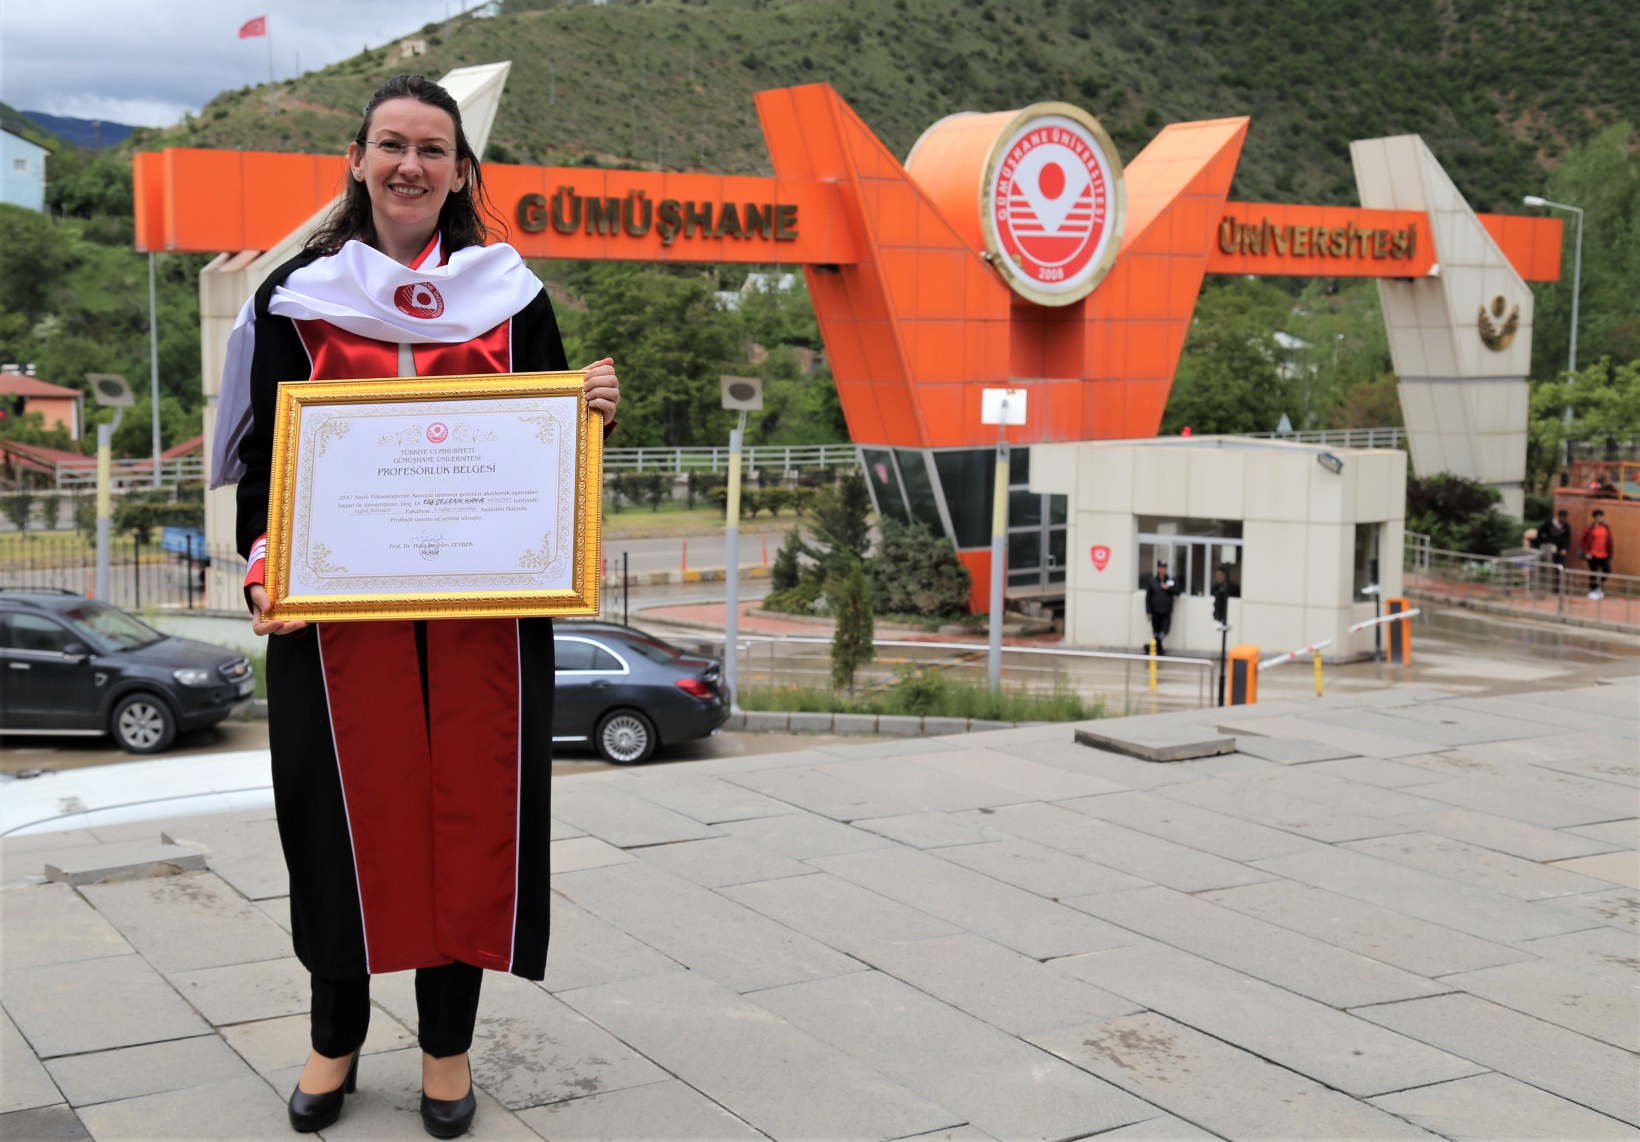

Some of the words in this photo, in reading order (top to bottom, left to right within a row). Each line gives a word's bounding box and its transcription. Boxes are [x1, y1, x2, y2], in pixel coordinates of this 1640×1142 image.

[997, 131, 1049, 221] GÜMÜŞHANE
[517, 186, 799, 246] GÜMÜŞHANE
[1219, 216, 1417, 259] ÜNİVERSİTESİ
[1038, 267, 1064, 280] 2008
[430, 447, 475, 455] CUMHURİYETİ
[393, 456, 434, 464] GÜMÜŞHANE
[377, 465, 450, 476] PROFESÖRLÜK
[453, 463, 496, 474] BELGESİ
